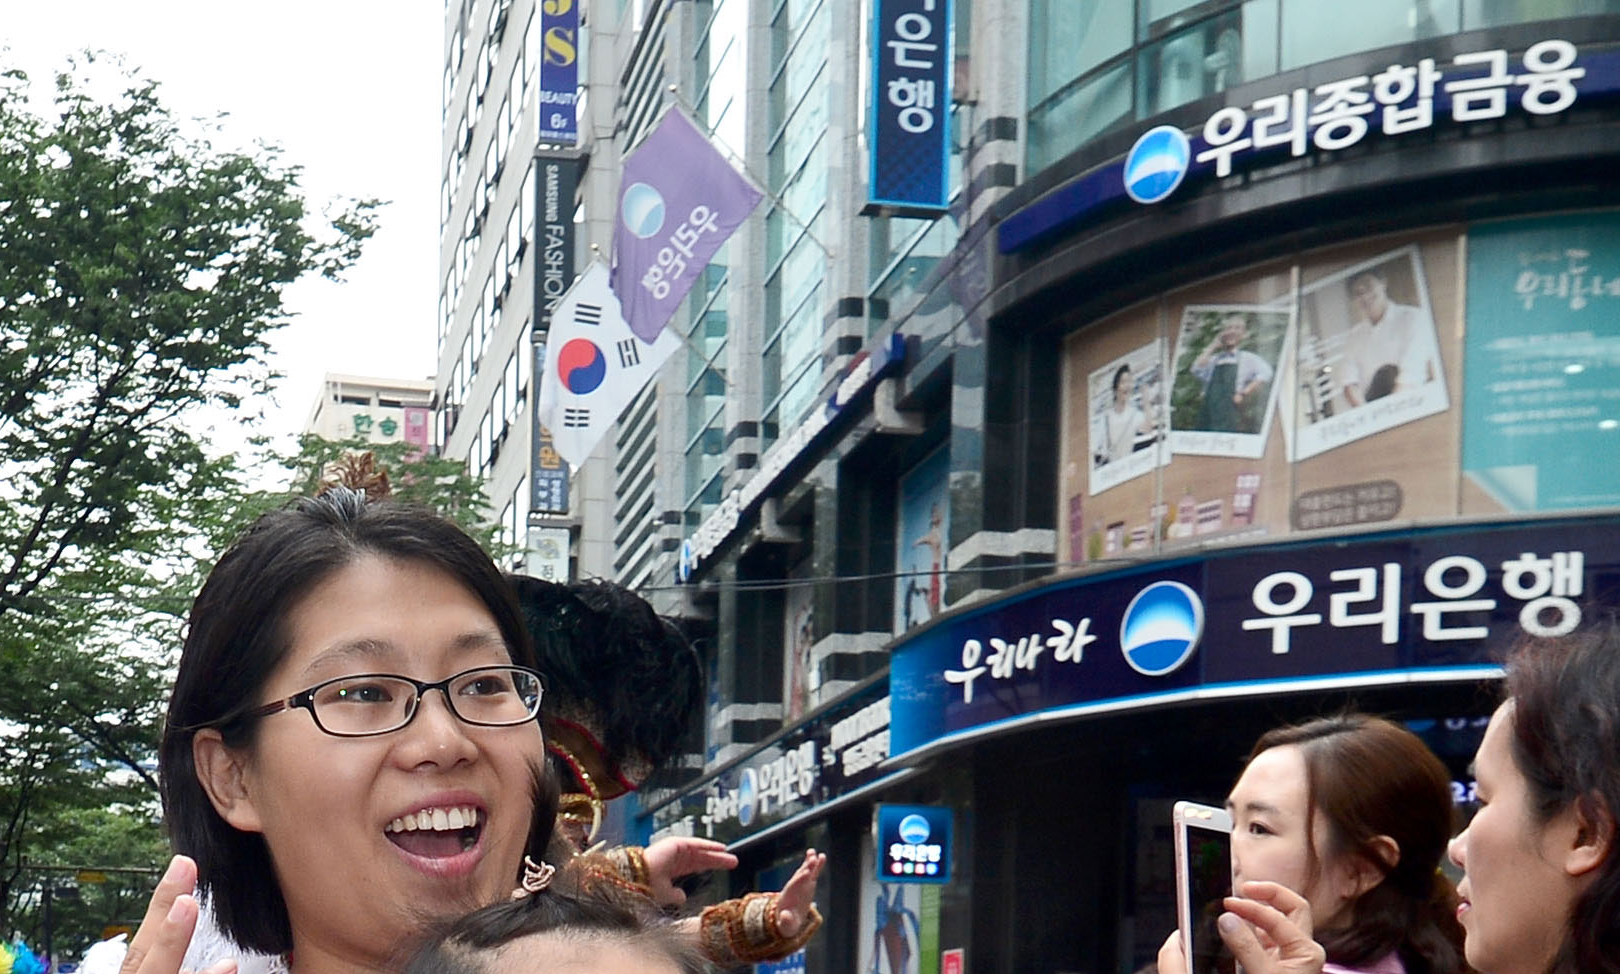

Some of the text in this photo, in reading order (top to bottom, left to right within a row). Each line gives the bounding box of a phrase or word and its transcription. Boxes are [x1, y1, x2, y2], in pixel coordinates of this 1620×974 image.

[540, 90, 577, 105] BEAUTY
[886, 0, 938, 133] 은행
[1196, 39, 1586, 177] 우리종합금융
[544, 164, 560, 222] SAMSUNG
[641, 205, 719, 300] 우리은행
[1241, 551, 1585, 654] 우리은행
[943, 617, 1098, 705] 우리나라
